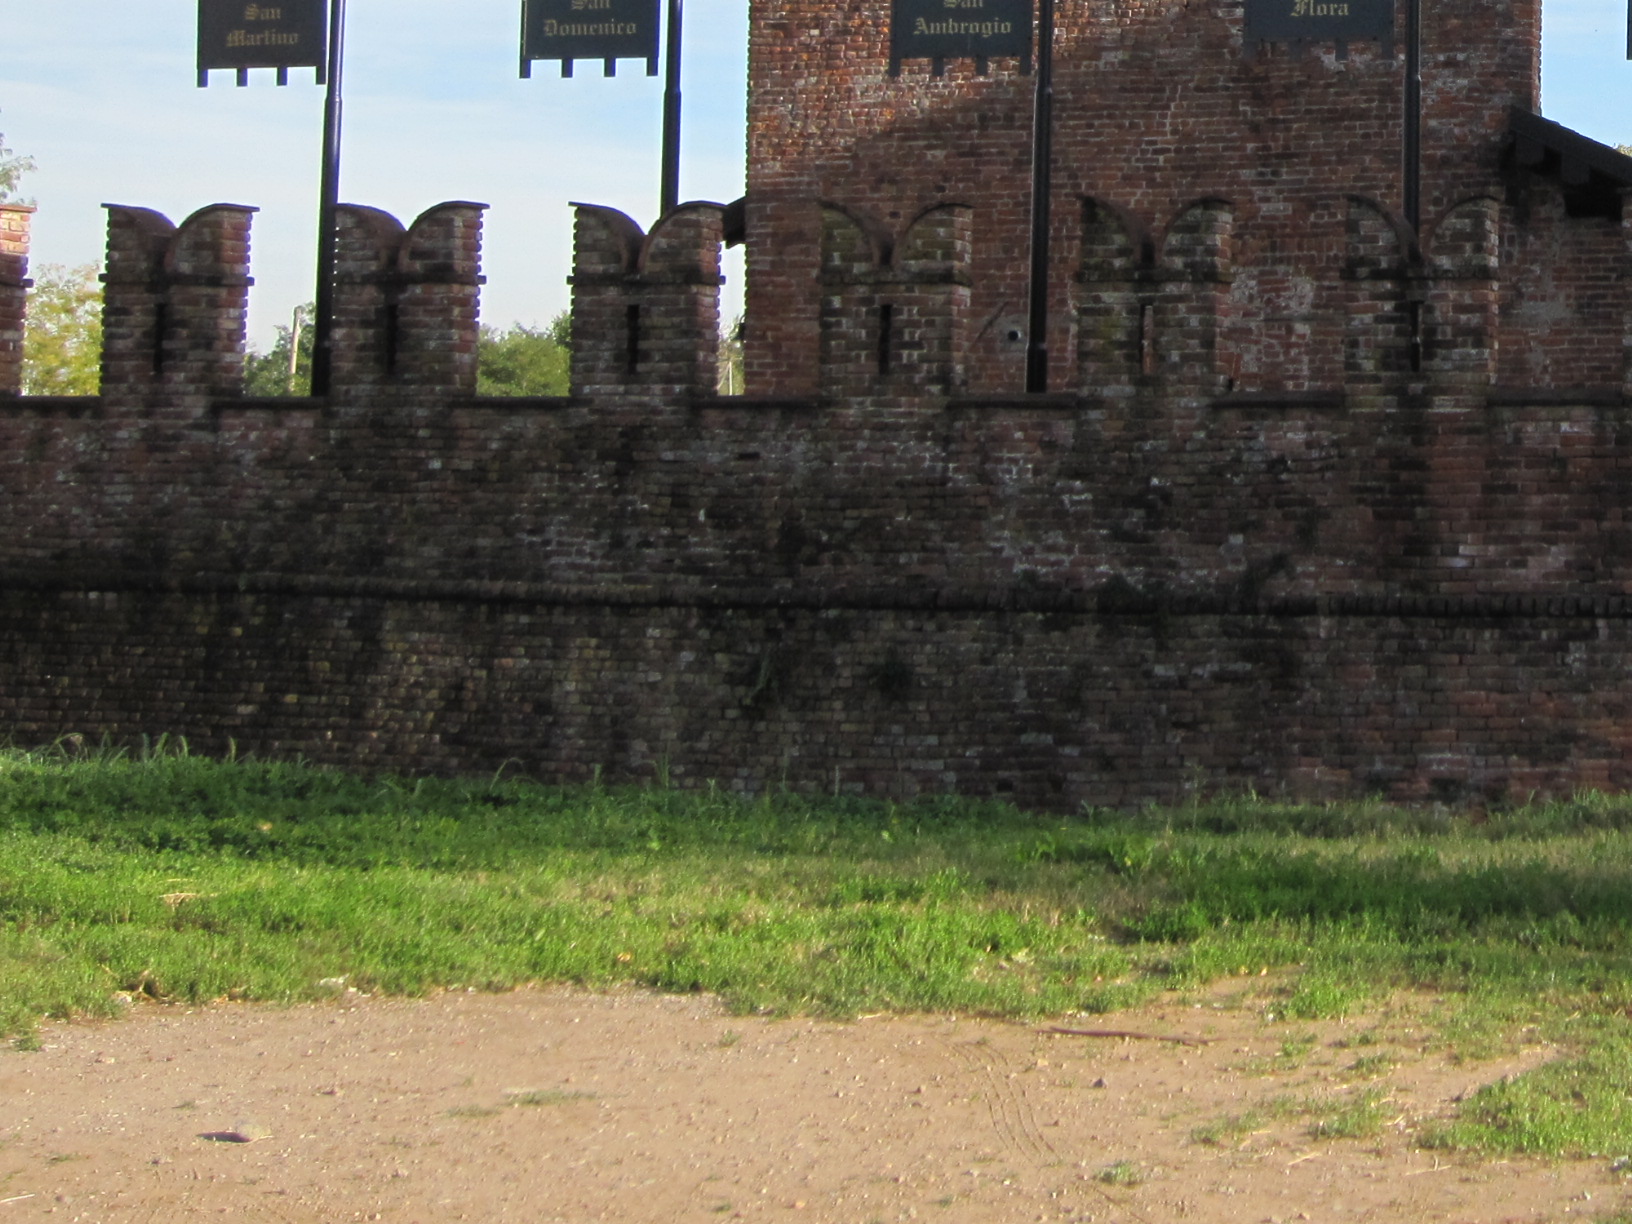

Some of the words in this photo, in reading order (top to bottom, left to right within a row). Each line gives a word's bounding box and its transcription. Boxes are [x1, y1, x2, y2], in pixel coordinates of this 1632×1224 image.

[244, 3, 281, 20] San
[543, 18, 637, 36] Domenico
[913, 17, 1011, 38] Ambrogio
[226, 29, 299, 47] Martino
